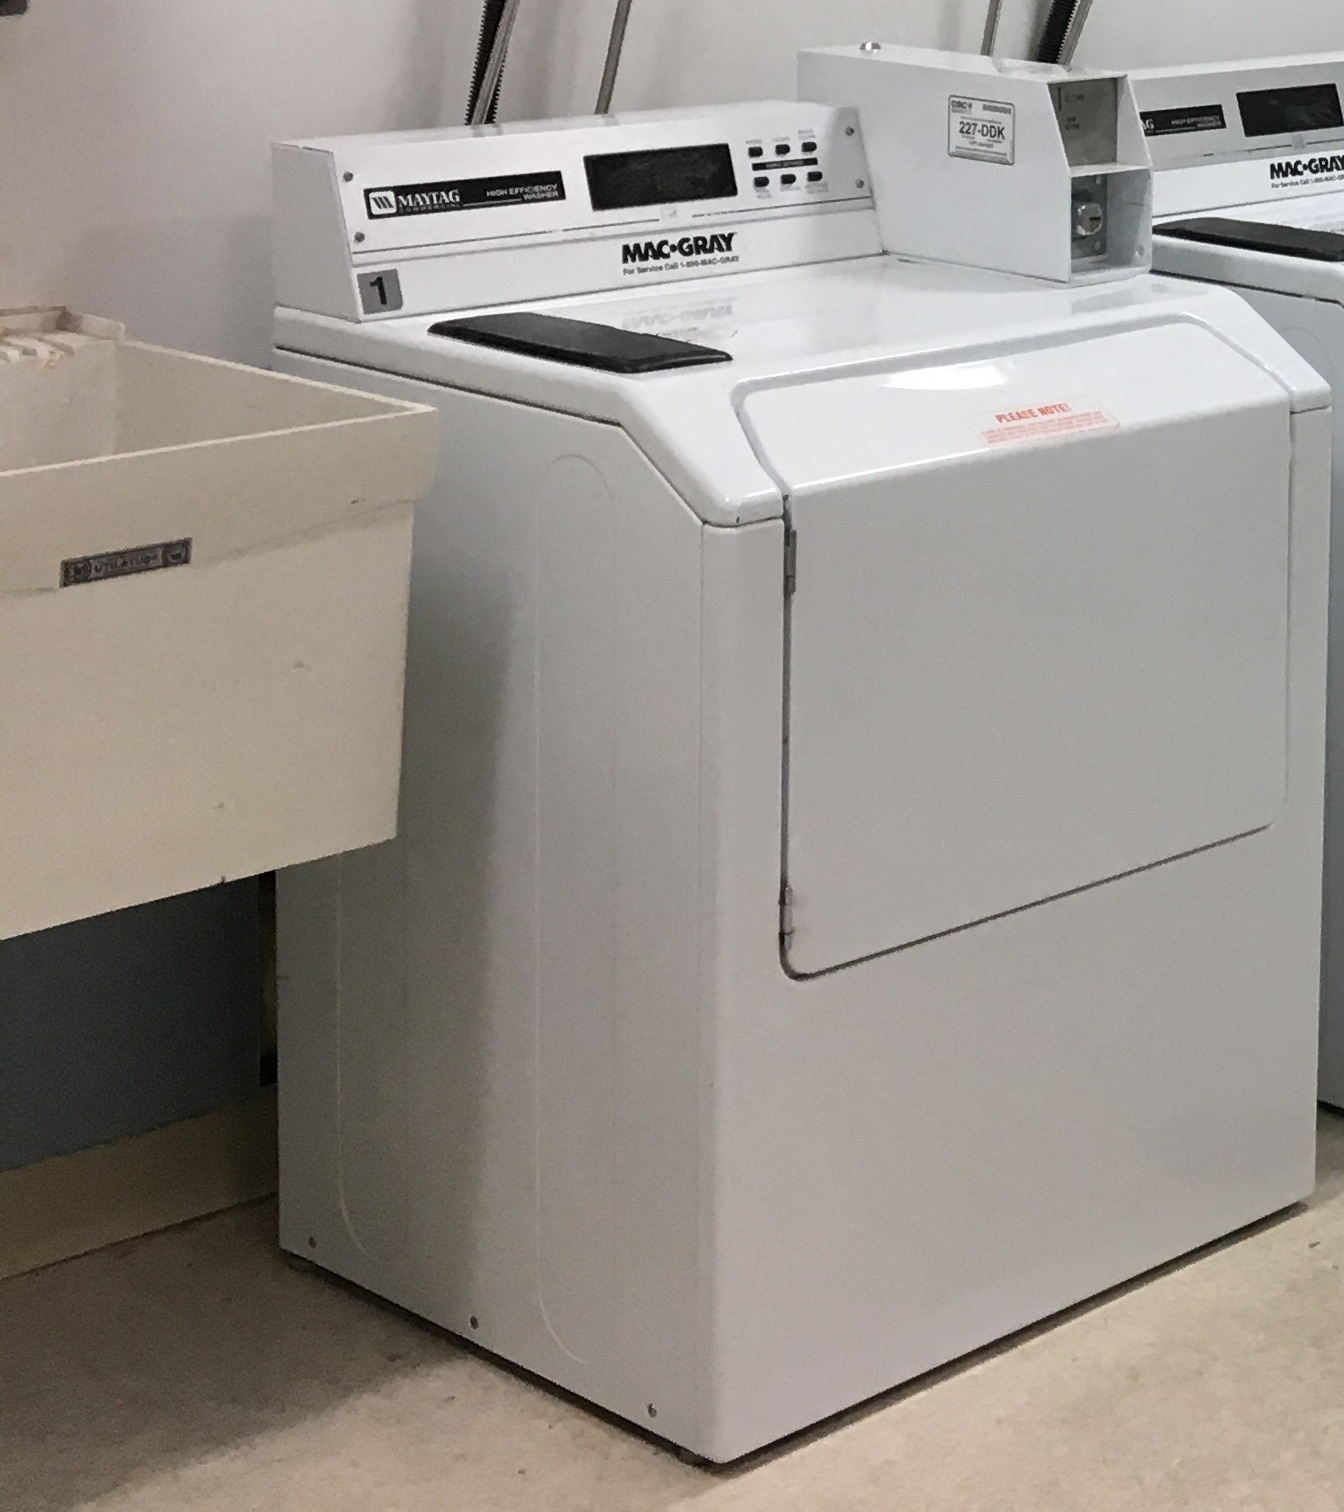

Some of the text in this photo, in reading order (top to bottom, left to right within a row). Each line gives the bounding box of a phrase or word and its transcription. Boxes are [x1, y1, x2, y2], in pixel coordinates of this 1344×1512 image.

[959, 120, 1006, 140] 227-DDK
[398, 189, 460, 208] MAYTAG
[623, 268, 634, 276] For
[636, 265, 663, 274] Service
[665, 262, 679, 271] Call
[369, 276, 387, 305] 1
[995, 403, 1072, 423] PLEASE NOTE!
